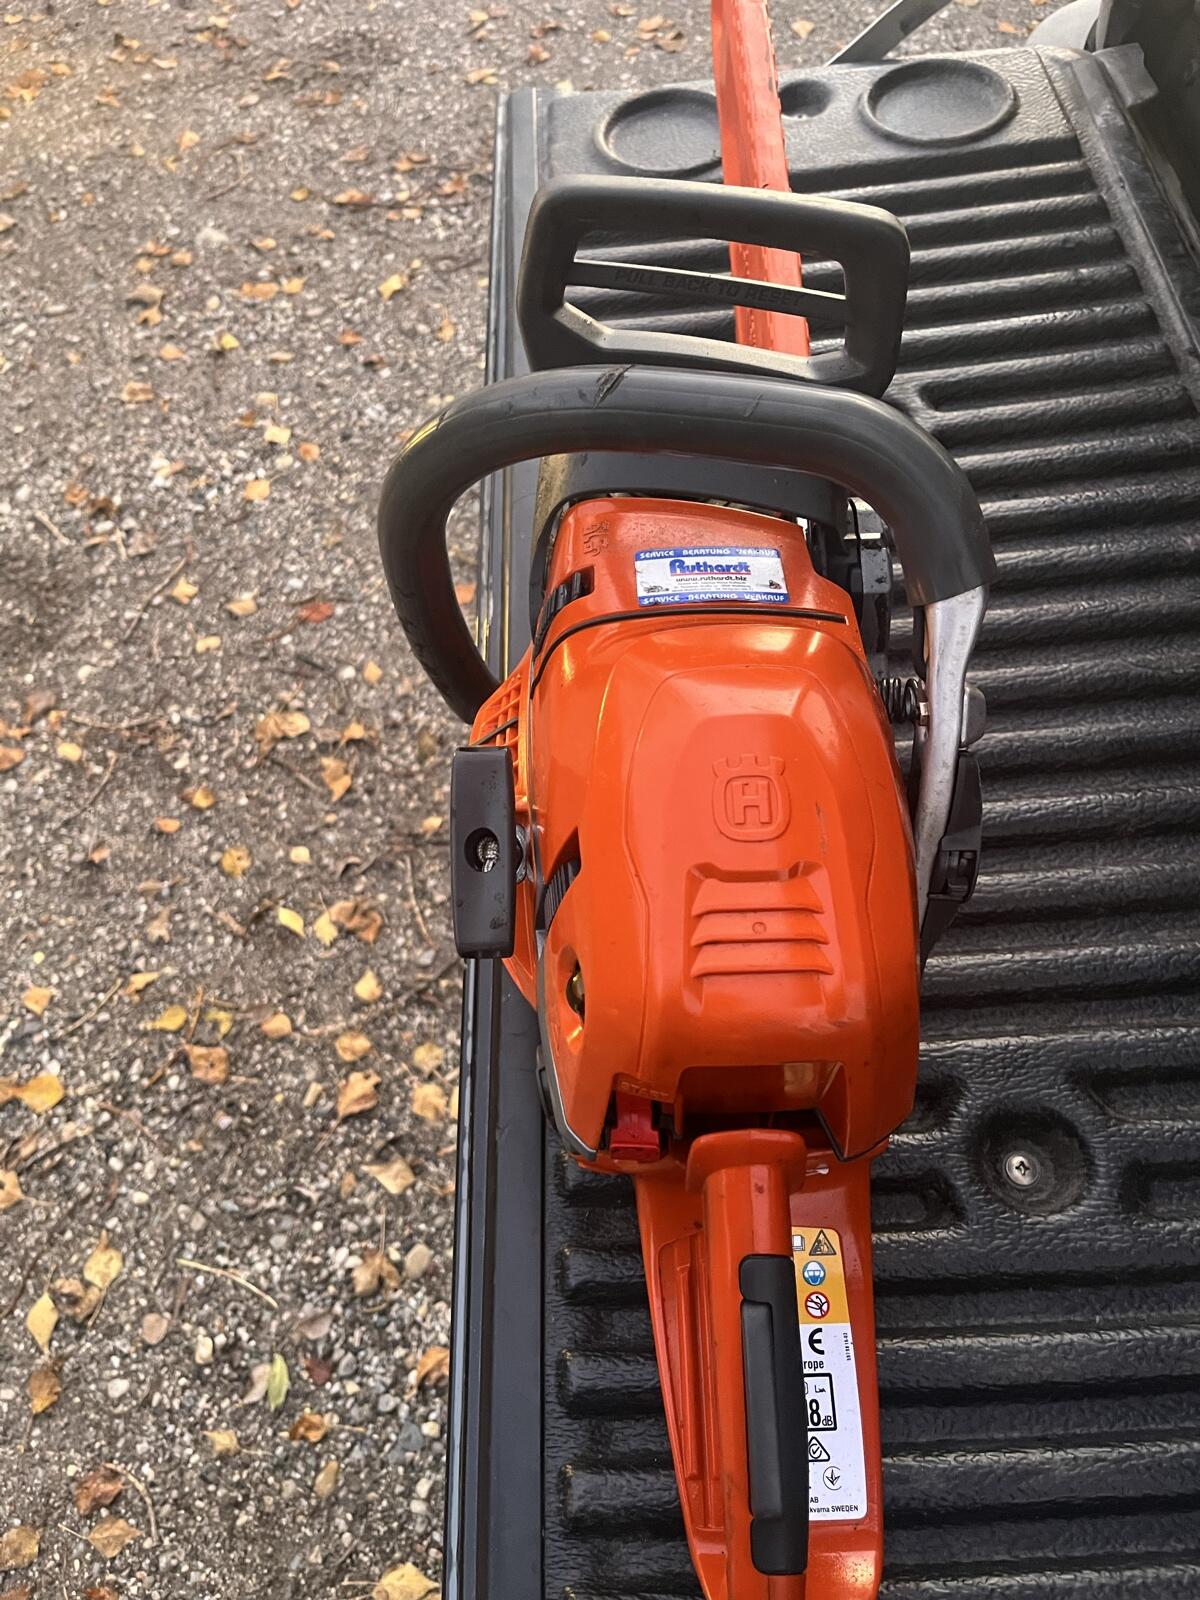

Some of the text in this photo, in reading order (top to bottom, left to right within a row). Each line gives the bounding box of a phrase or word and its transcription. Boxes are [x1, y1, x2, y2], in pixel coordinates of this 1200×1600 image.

[614, 269, 805, 307] PULL BACK TO RESET
[639, 548, 777, 560] SERVICE BERATUNG VERKAUF
[669, 558, 752, 574] Ruthardt
[675, 574, 748, 583] www.ruthardt.biz
[642, 593, 785, 605] SERVICE BERATUNG VERKAUF
[803, 1360, 825, 1372] rope
[821, 1415, 834, 1427] dB
[831, 1504, 859, 1513] SWEDEN
